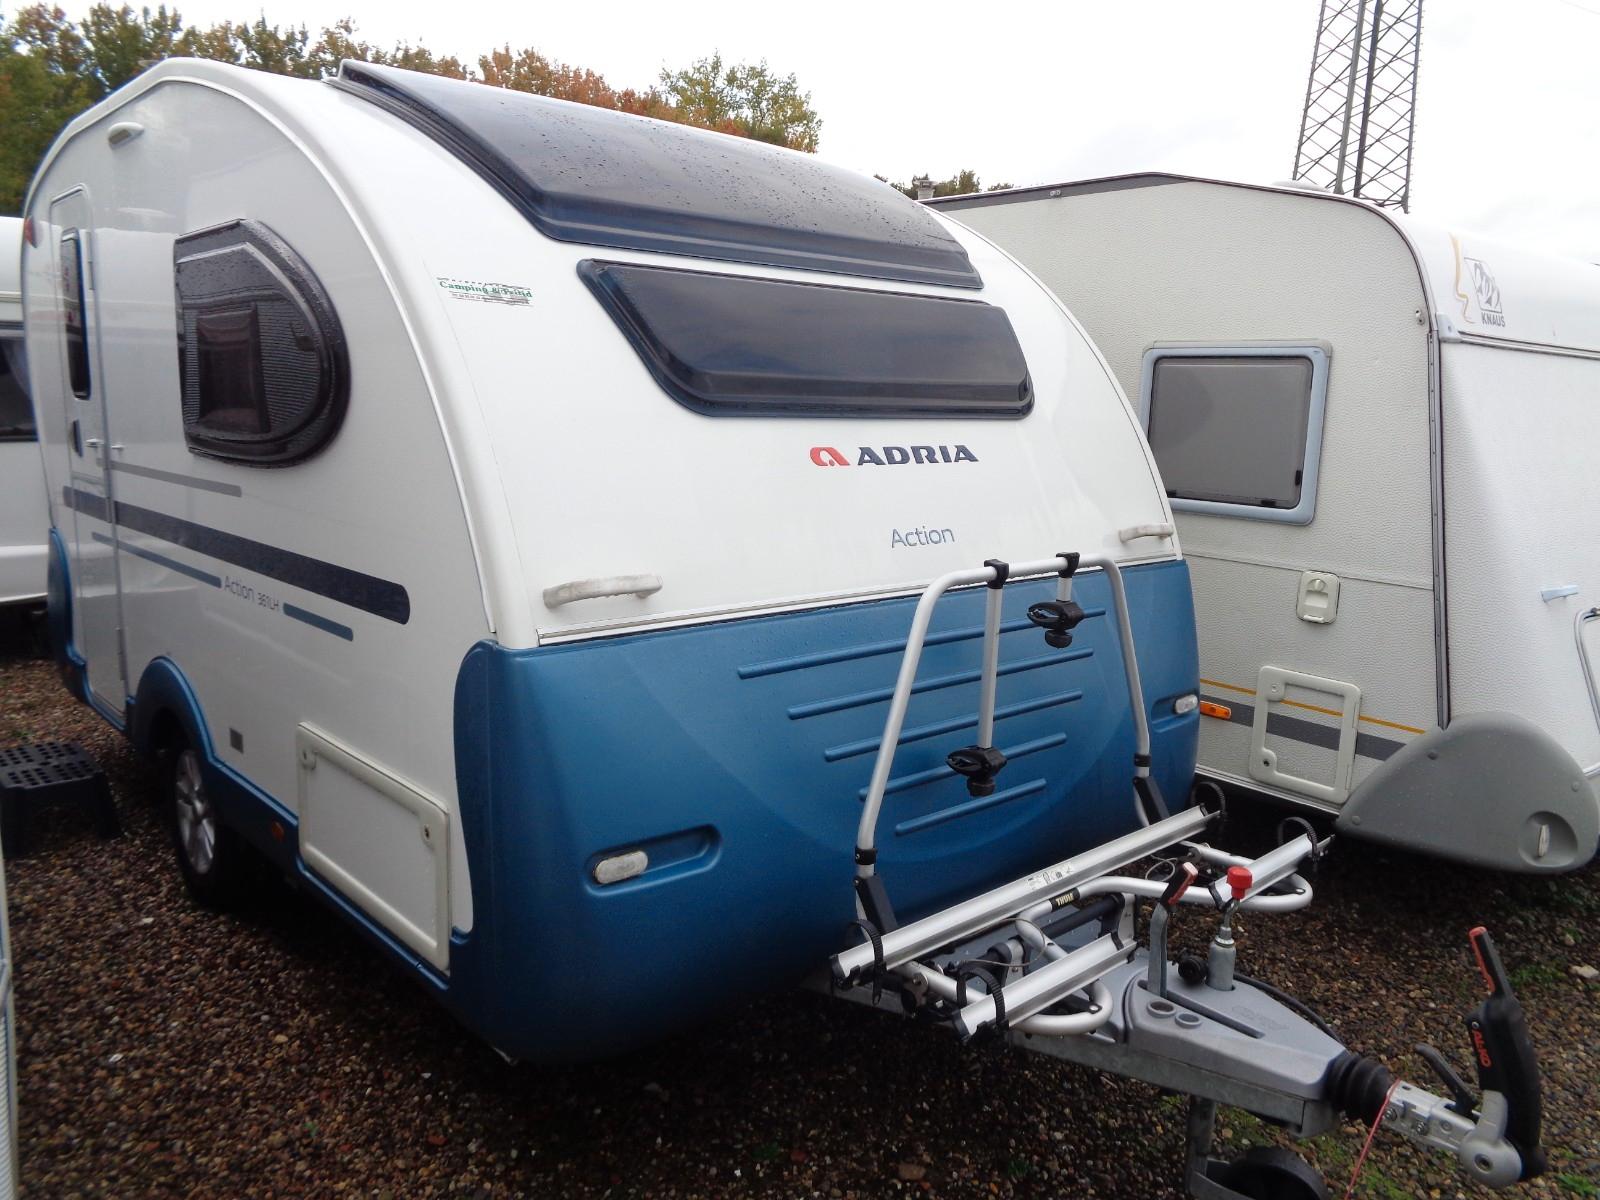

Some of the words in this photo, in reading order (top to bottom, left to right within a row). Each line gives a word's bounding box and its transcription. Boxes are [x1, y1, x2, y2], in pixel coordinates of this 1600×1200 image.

[439, 280, 488, 295] Camping
[1481, 311, 1506, 327] KNAUS
[857, 445, 979, 466] ADRIA
[891, 525, 956, 549] Action
[224, 575, 255, 603] Action
[1055, 891, 1075, 907] THULE
